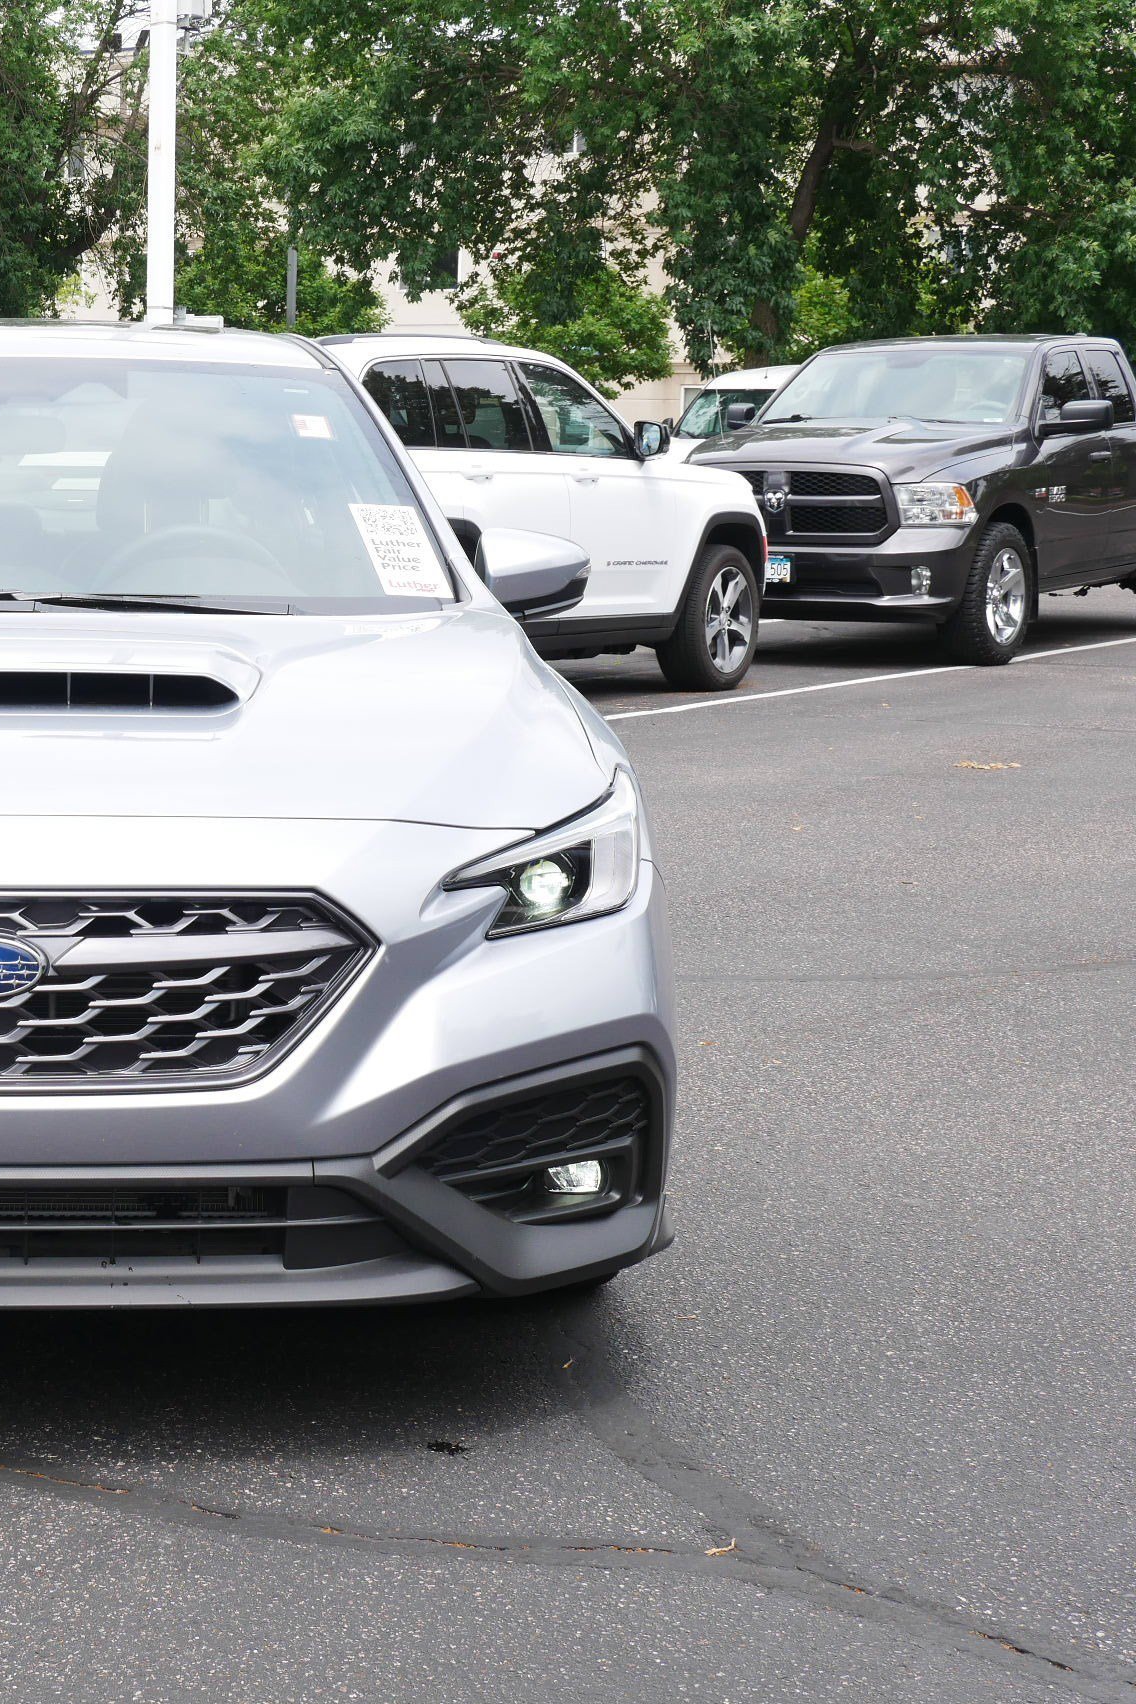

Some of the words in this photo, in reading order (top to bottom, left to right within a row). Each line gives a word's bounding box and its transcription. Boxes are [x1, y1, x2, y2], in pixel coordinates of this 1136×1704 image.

[370, 539, 421, 548] Luther
[374, 547, 401, 555] Fair
[377, 554, 421, 564] Value
[381, 562, 421, 572] Price
[771, 562, 788, 576] 505
[388, 580, 439, 590] Luther
